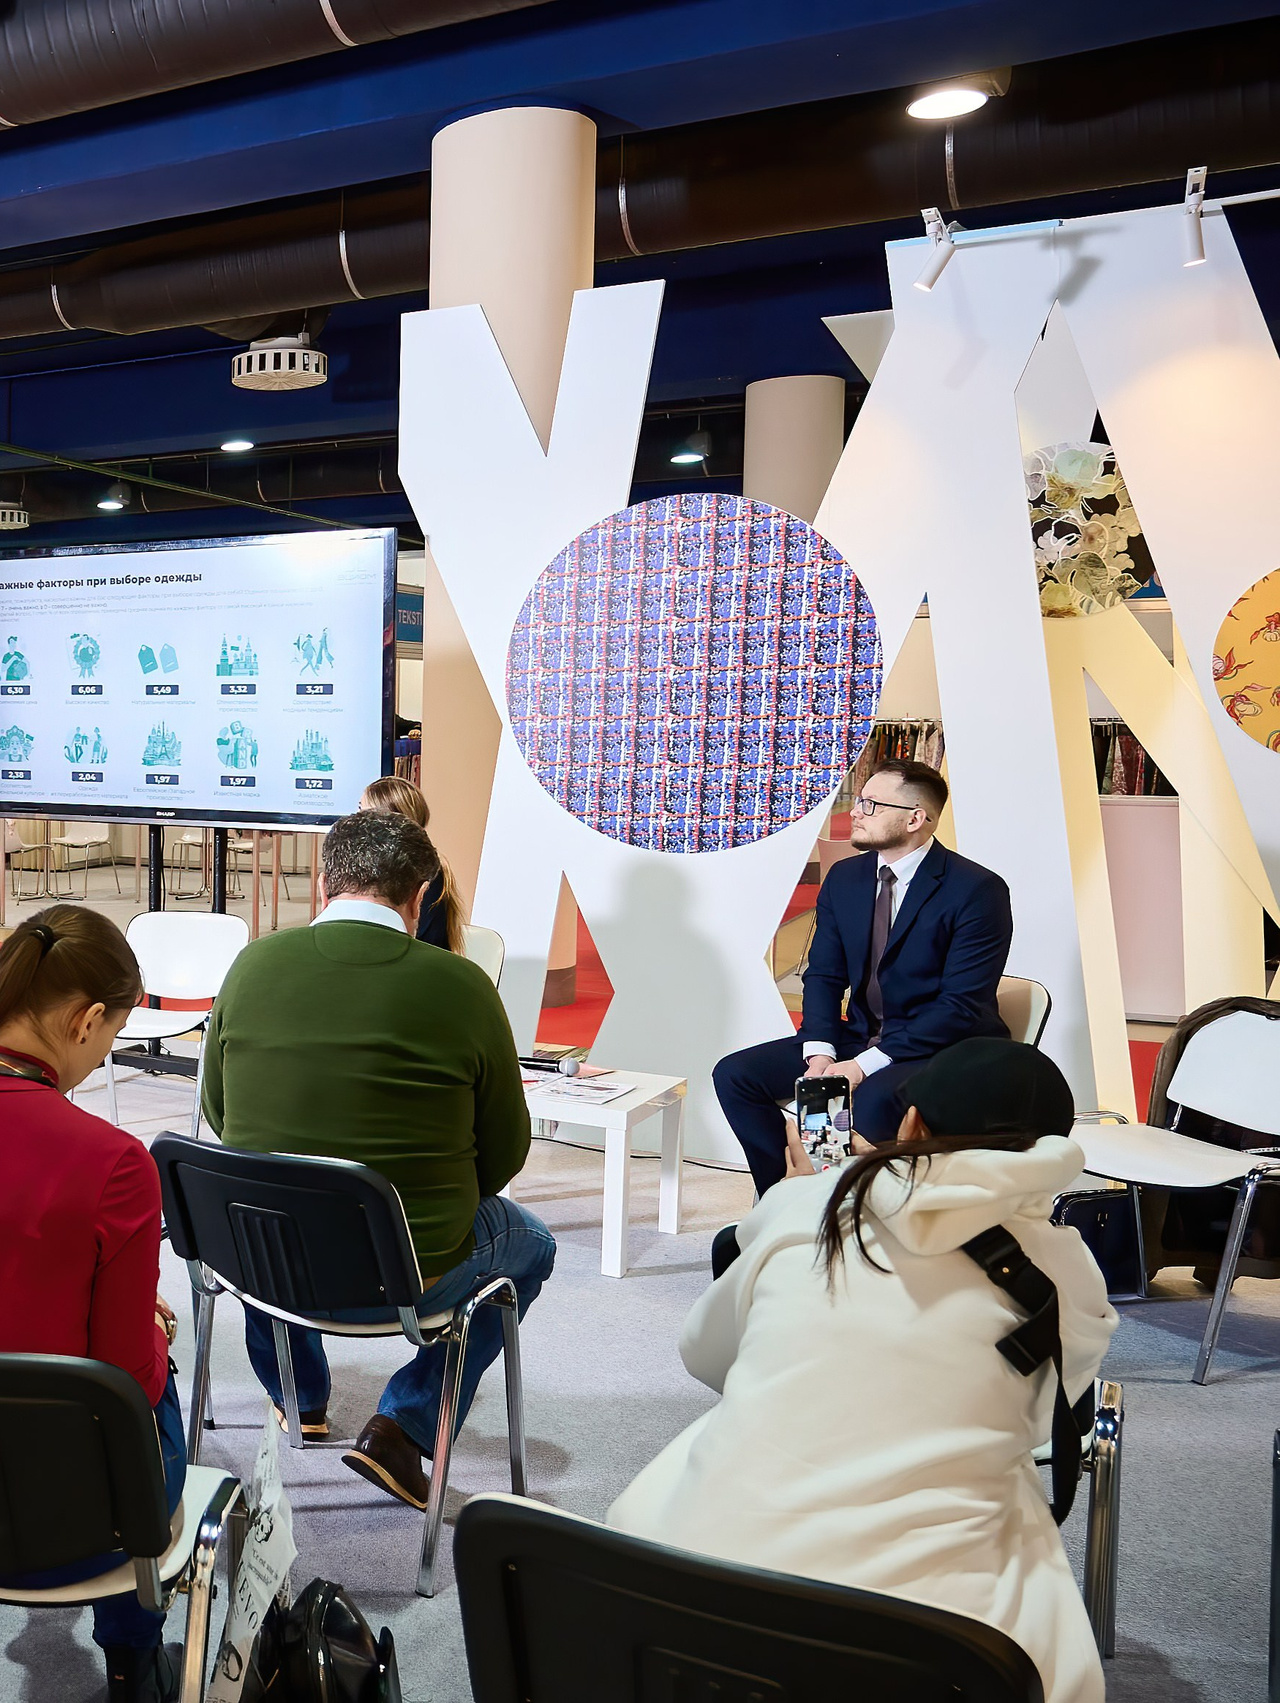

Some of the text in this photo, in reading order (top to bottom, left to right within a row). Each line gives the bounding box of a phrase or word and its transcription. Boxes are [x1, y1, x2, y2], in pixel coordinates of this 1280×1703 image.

[36, 578, 84, 590] факторы
[86, 578, 107, 589] при
[109, 574, 152, 585] выборе
[154, 572, 202, 584] одежды
[7, 686, 23, 695] 6,30
[78, 686, 96, 695] 6,06
[153, 686, 171, 695] 5,49
[229, 685, 248, 694] 3,32
[306, 685, 324, 694] 3,21
[8, 771, 24, 780] 2,38
[78, 773, 96, 782] 2,04
[153, 775, 171, 784] 1,97
[229, 777, 247, 787] 1,97
[304, 779, 323, 789] 1,72
